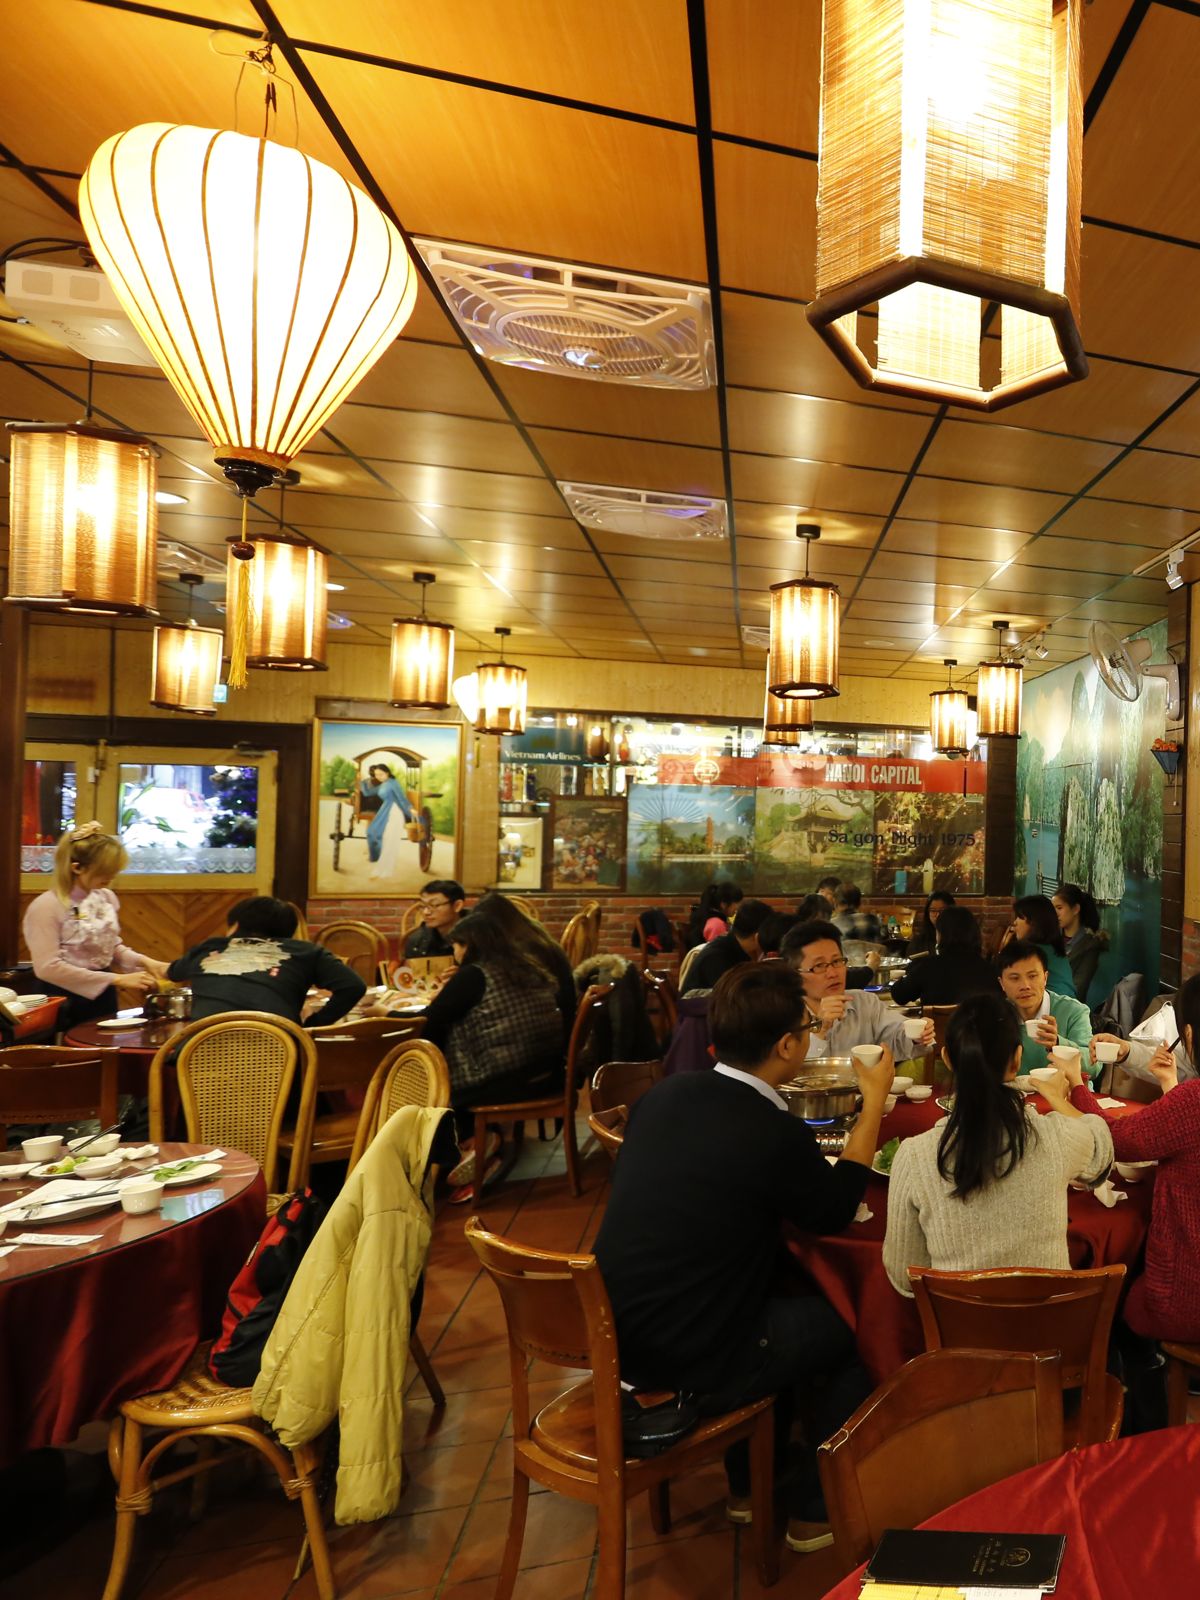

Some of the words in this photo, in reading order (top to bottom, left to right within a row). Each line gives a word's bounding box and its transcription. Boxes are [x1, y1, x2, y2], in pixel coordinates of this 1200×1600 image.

[504, 750, 545, 759] Vietnam
[546, 751, 581, 761] Airlines
[825, 763, 865, 783] HANOI
[871, 765, 922, 785] CAPITAL
[941, 832, 976, 846] 1975
